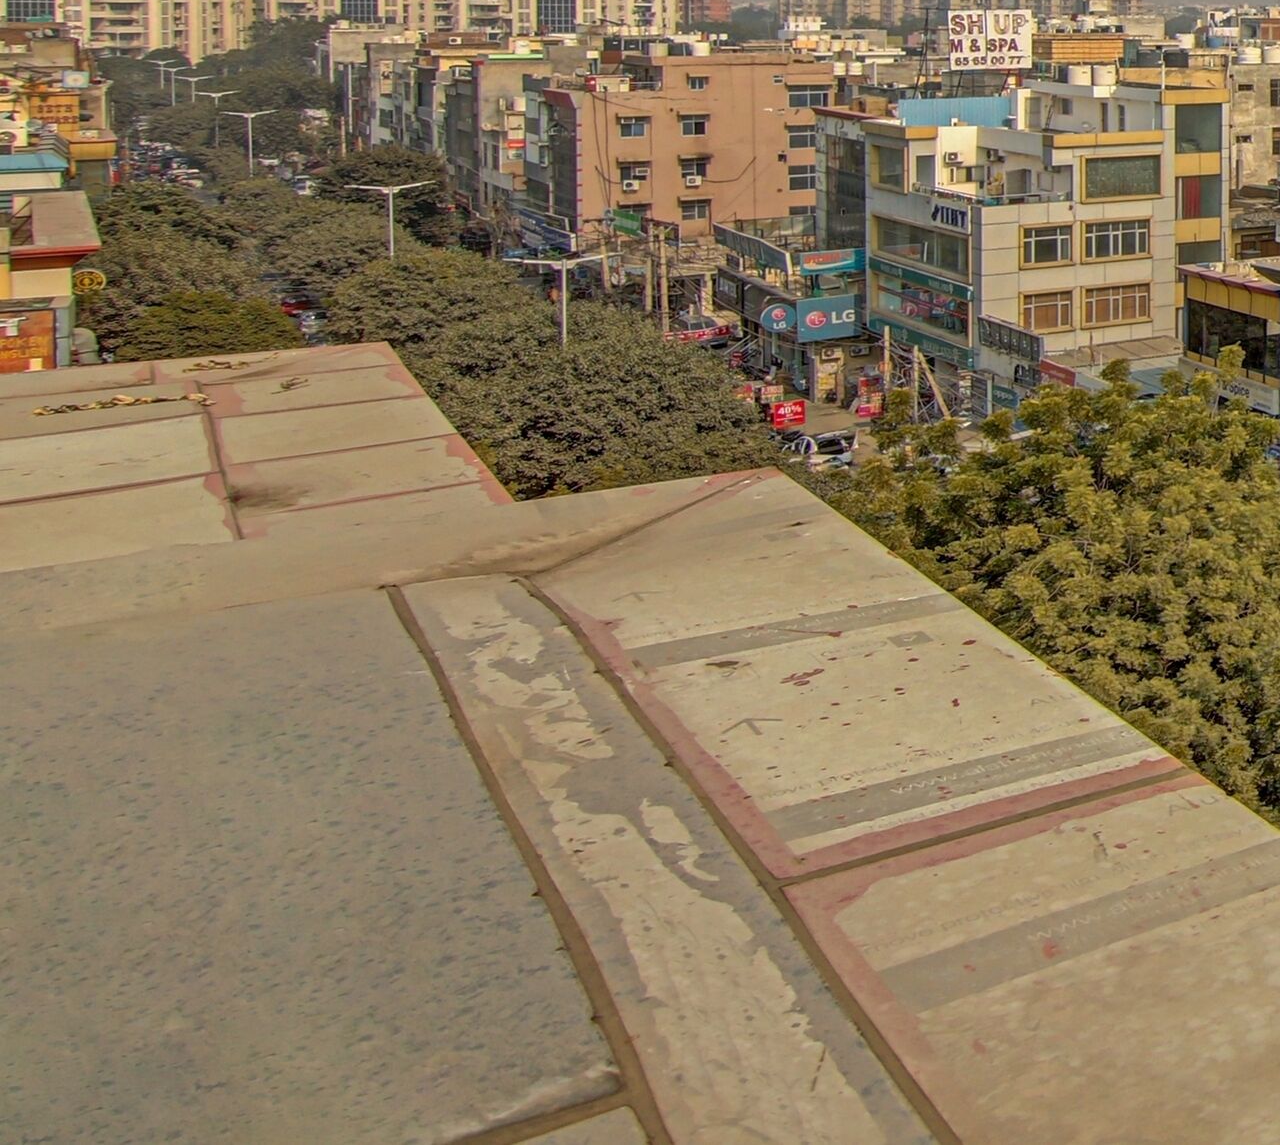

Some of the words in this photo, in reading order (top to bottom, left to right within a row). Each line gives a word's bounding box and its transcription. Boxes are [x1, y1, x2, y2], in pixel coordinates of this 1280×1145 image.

[950, 13, 984, 35] SH
[993, 13, 1027, 35] UP
[969, 38, 981, 52] &
[986, 38, 1019, 52] SPA
[990, 56, 1006, 65] 00
[1007, 56, 1023, 65] 77
[831, 309, 856, 324] LG
[773, 321, 787, 329] LG
[779, 405, 802, 414] 40%
